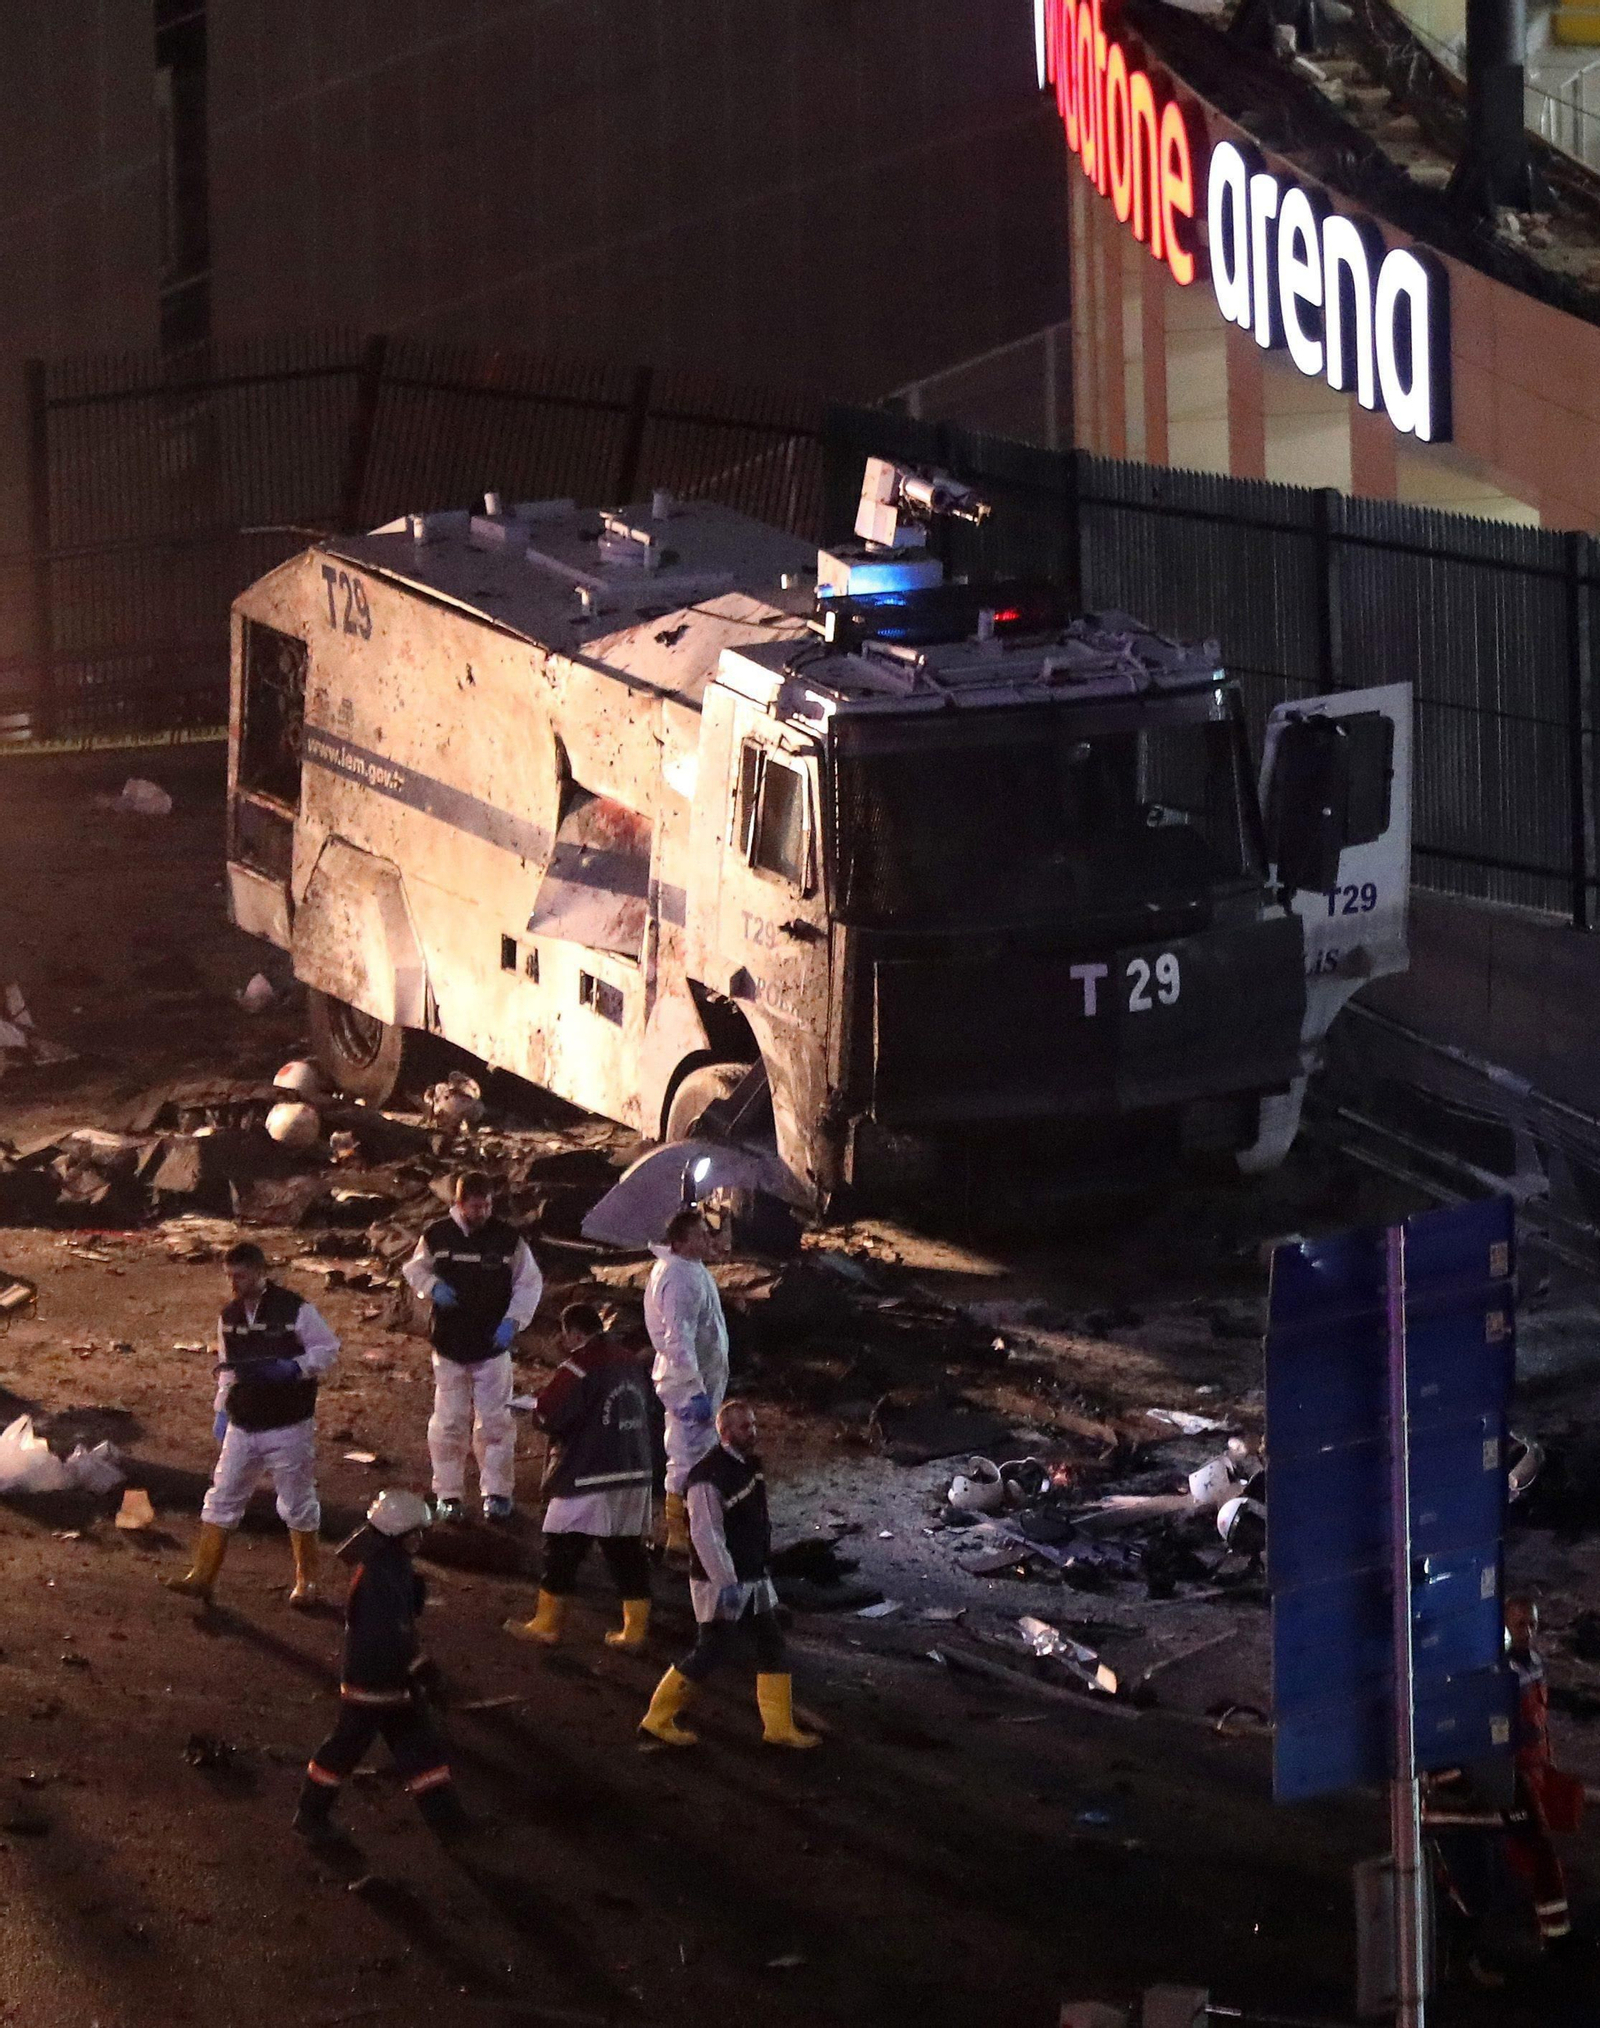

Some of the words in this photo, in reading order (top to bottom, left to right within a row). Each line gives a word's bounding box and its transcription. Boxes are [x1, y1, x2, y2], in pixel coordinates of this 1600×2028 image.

[1208, 141, 1431, 442] arena
[321, 564, 372, 640] T29
[741, 909, 776, 949] T29
[1323, 883, 1377, 917] T29
[1069, 963, 1108, 1016] T
[1126, 952, 1180, 1012] 29
